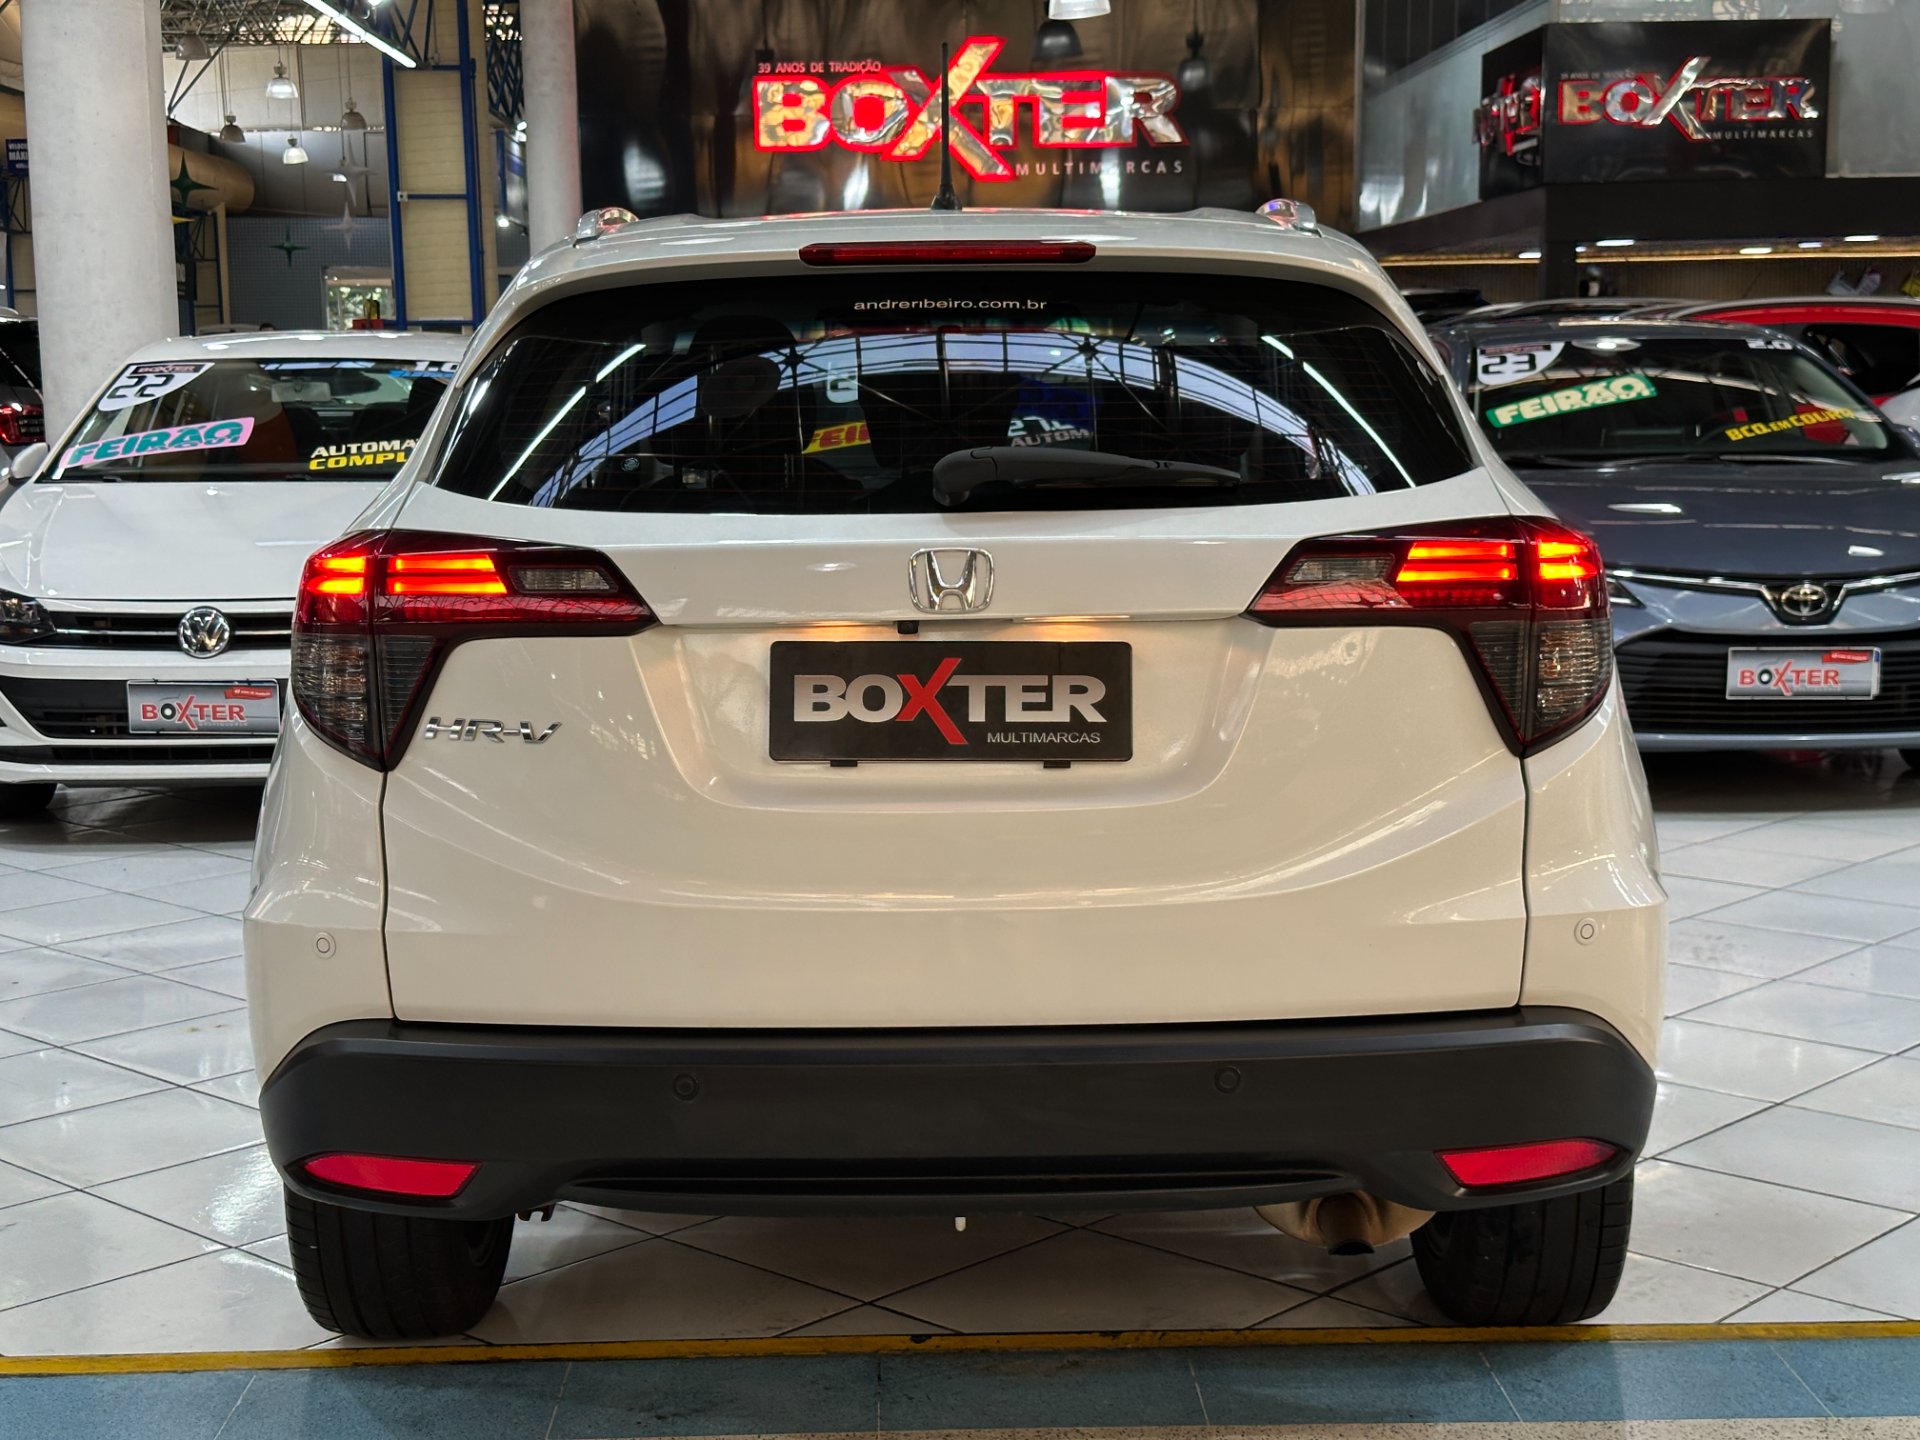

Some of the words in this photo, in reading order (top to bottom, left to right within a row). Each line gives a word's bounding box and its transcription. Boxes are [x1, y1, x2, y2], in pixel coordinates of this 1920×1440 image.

[757, 62, 772, 74] 39
[775, 61, 806, 74] ANOS
[809, 61, 825, 73] DE
[828, 58, 882, 74] TRADIÇÃO
[752, 35, 1189, 182] BOXTER
[1557, 56, 1820, 142] BOXTER
[1712, 128, 1814, 140] MULTIMARCAS
[1015, 159, 1183, 176] MULTIMRCAS
[853, 297, 1047, 311] andreribeiro.com.br
[1481, 352, 1537, 375] 23
[106, 373, 175, 399] 22
[1738, 659, 1841, 697] BOXTER
[140, 694, 249, 731] BOXTER
[793, 657, 1108, 745] BOXTER
[424, 716, 562, 744] HR-V
[986, 731, 1101, 745] MULTIMARCAS
